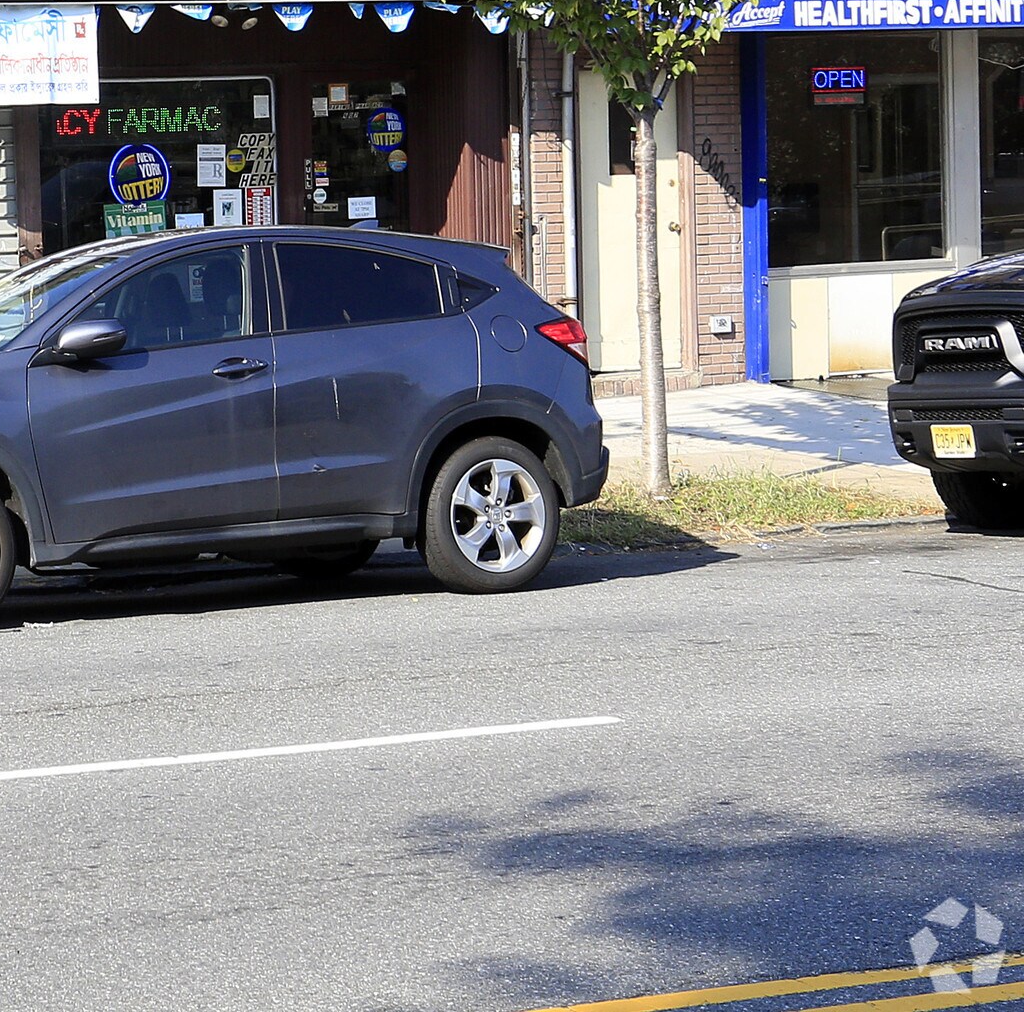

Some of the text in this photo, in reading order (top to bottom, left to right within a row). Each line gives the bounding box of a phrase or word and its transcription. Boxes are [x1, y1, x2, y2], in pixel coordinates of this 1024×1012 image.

[281, 5, 302, 15] PLAY
[383, 7, 404, 17] PLAY
[732, 0, 786, 26] Accept
[814, 70, 864, 88] OPEN
[107, 105, 222, 134] FARMAC
[240, 134, 275, 148] COPY
[370, 131, 404, 146] LOTTERY
[136, 151, 156, 164] NEW
[247, 147, 275, 160] FAX
[139, 163, 162, 178] YORK
[240, 173, 276, 187] HERE
[118, 175, 164, 201] LOTTERY
[107, 211, 163, 229] Vitamin
[924, 335, 991, 351] RAM
